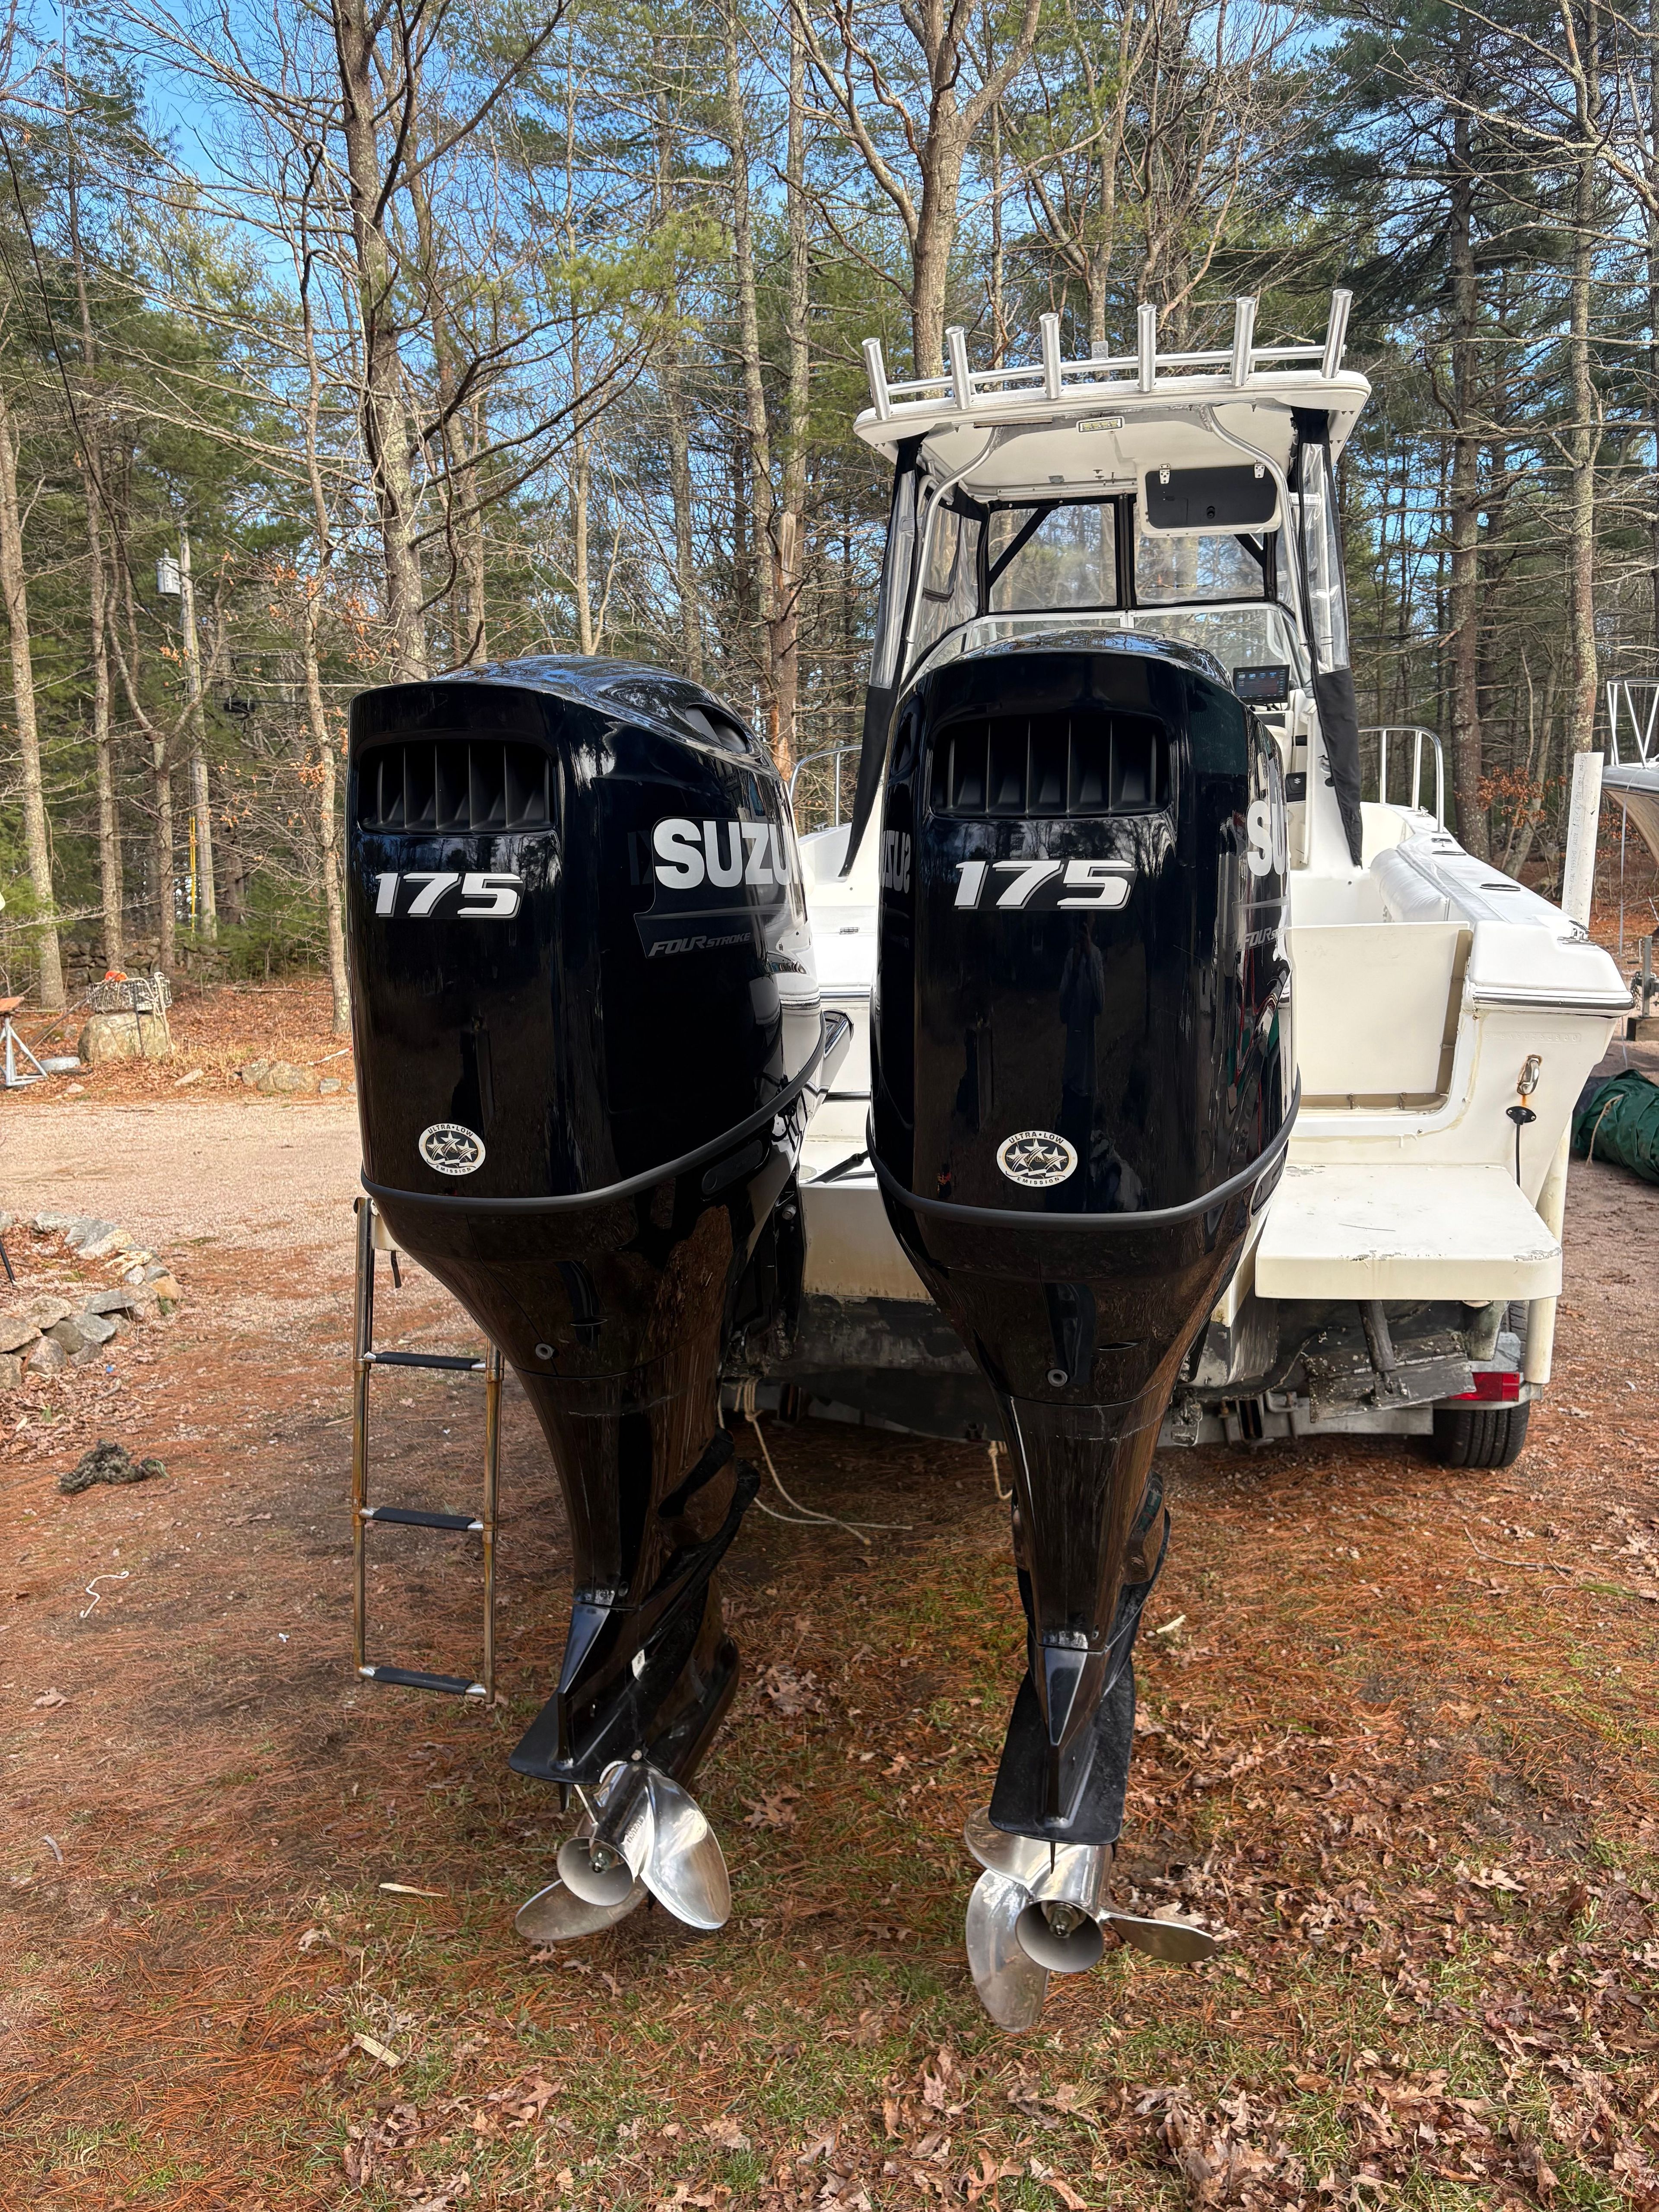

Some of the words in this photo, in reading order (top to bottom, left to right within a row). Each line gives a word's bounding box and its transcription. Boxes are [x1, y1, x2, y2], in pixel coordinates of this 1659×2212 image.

[954, 860, 1135, 909] 175
[375, 873, 524, 918] 175
[648, 935, 708, 957] FOUR
[706, 932, 751, 948] STROKE
[1241, 927, 1272, 949] FOUR
[428, 1124, 451, 1134] ULTRA
[456, 1126, 473, 1137] LOW
[1009, 1131, 1037, 1144] ULTRA
[1044, 1132, 1064, 1144] LOW
[436, 1165, 471, 1173] EMISSION
[1017, 1176, 1059, 1185] EMISSION
